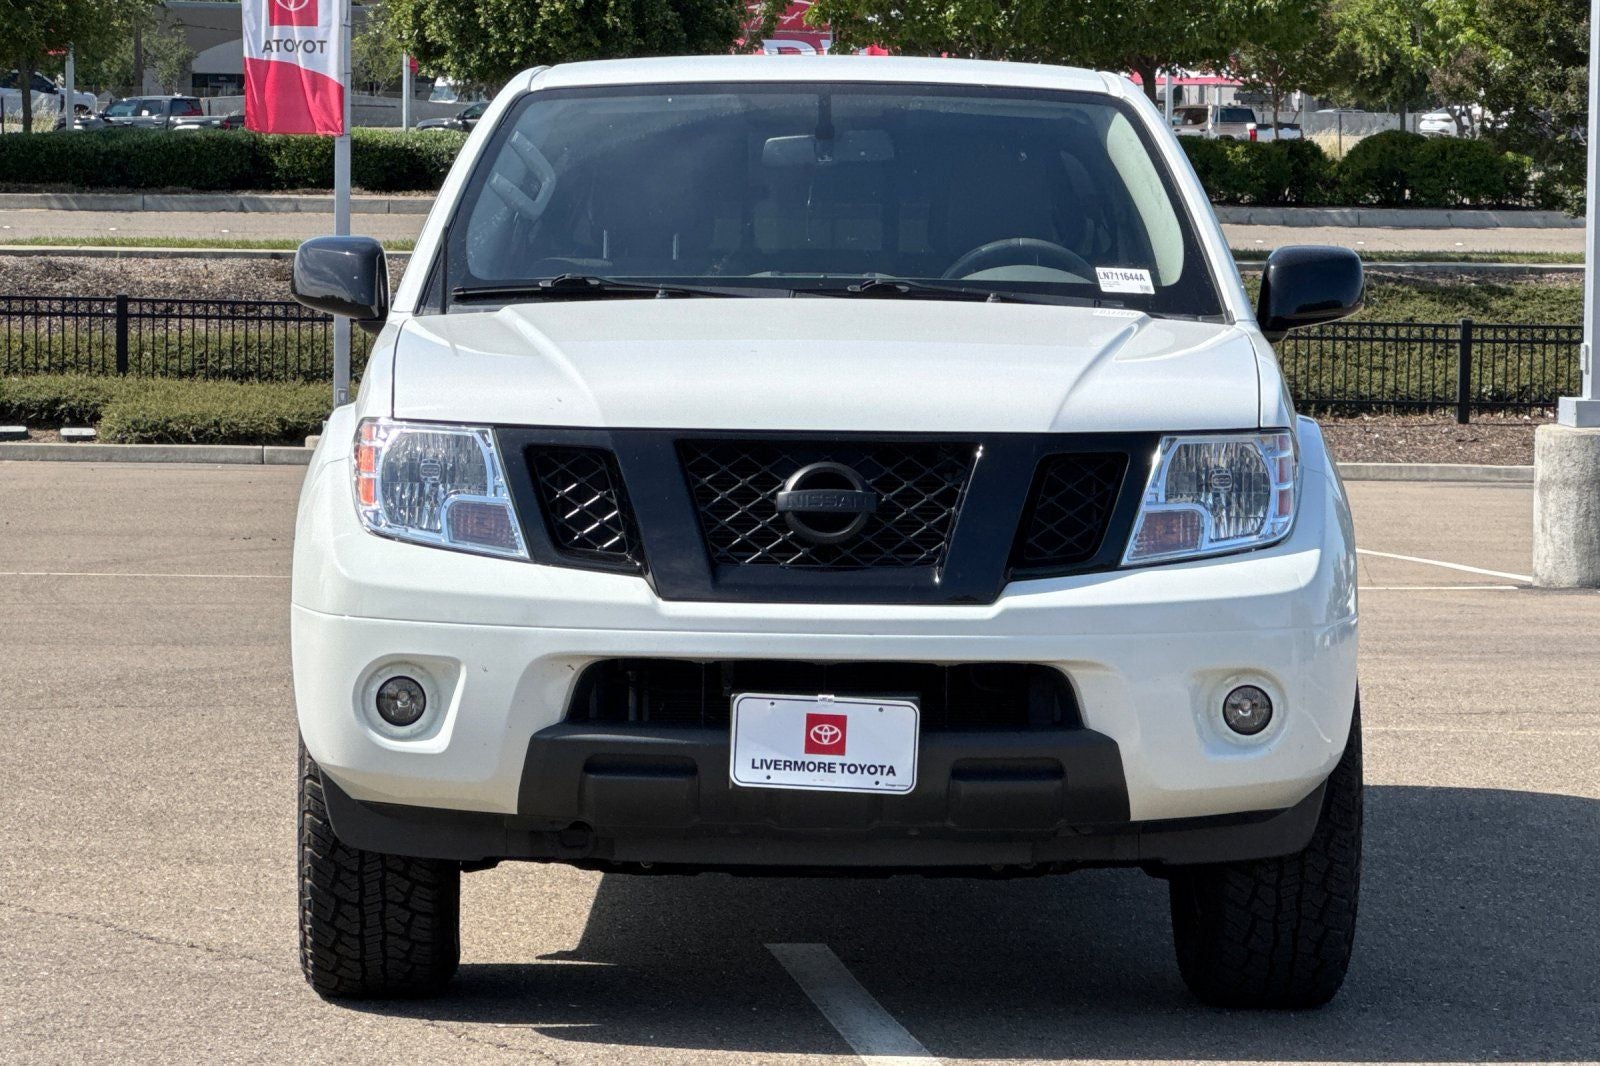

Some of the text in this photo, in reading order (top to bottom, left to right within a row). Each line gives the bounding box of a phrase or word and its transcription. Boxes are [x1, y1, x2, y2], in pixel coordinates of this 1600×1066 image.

[1097, 271, 1146, 282] LN711644A
[786, 494, 867, 507] NISSAN
[751, 758, 897, 777] LIVERMORE TOYOTA
